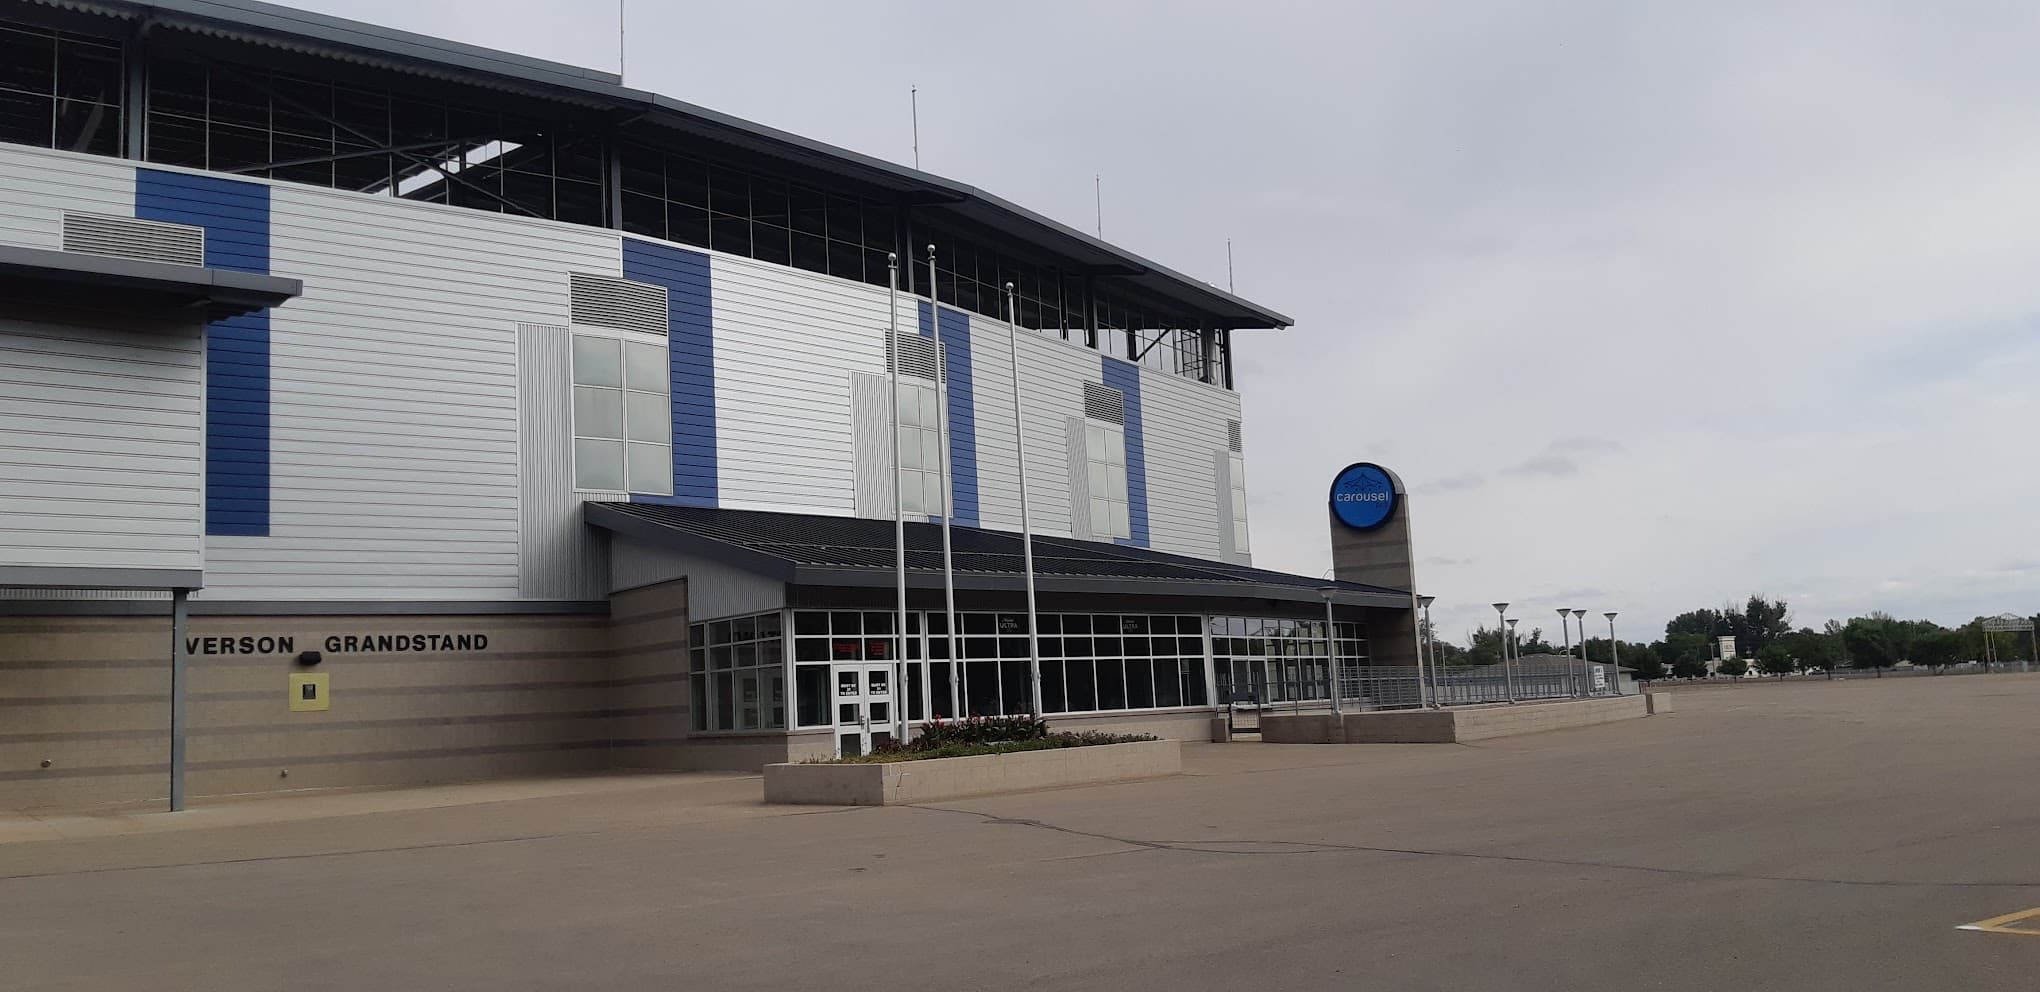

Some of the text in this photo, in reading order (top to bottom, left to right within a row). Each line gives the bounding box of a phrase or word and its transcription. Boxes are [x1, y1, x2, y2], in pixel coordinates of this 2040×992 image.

[1336, 491, 1389, 502] carousel
[186, 633, 488, 655] VERSON GRANDSTAND
